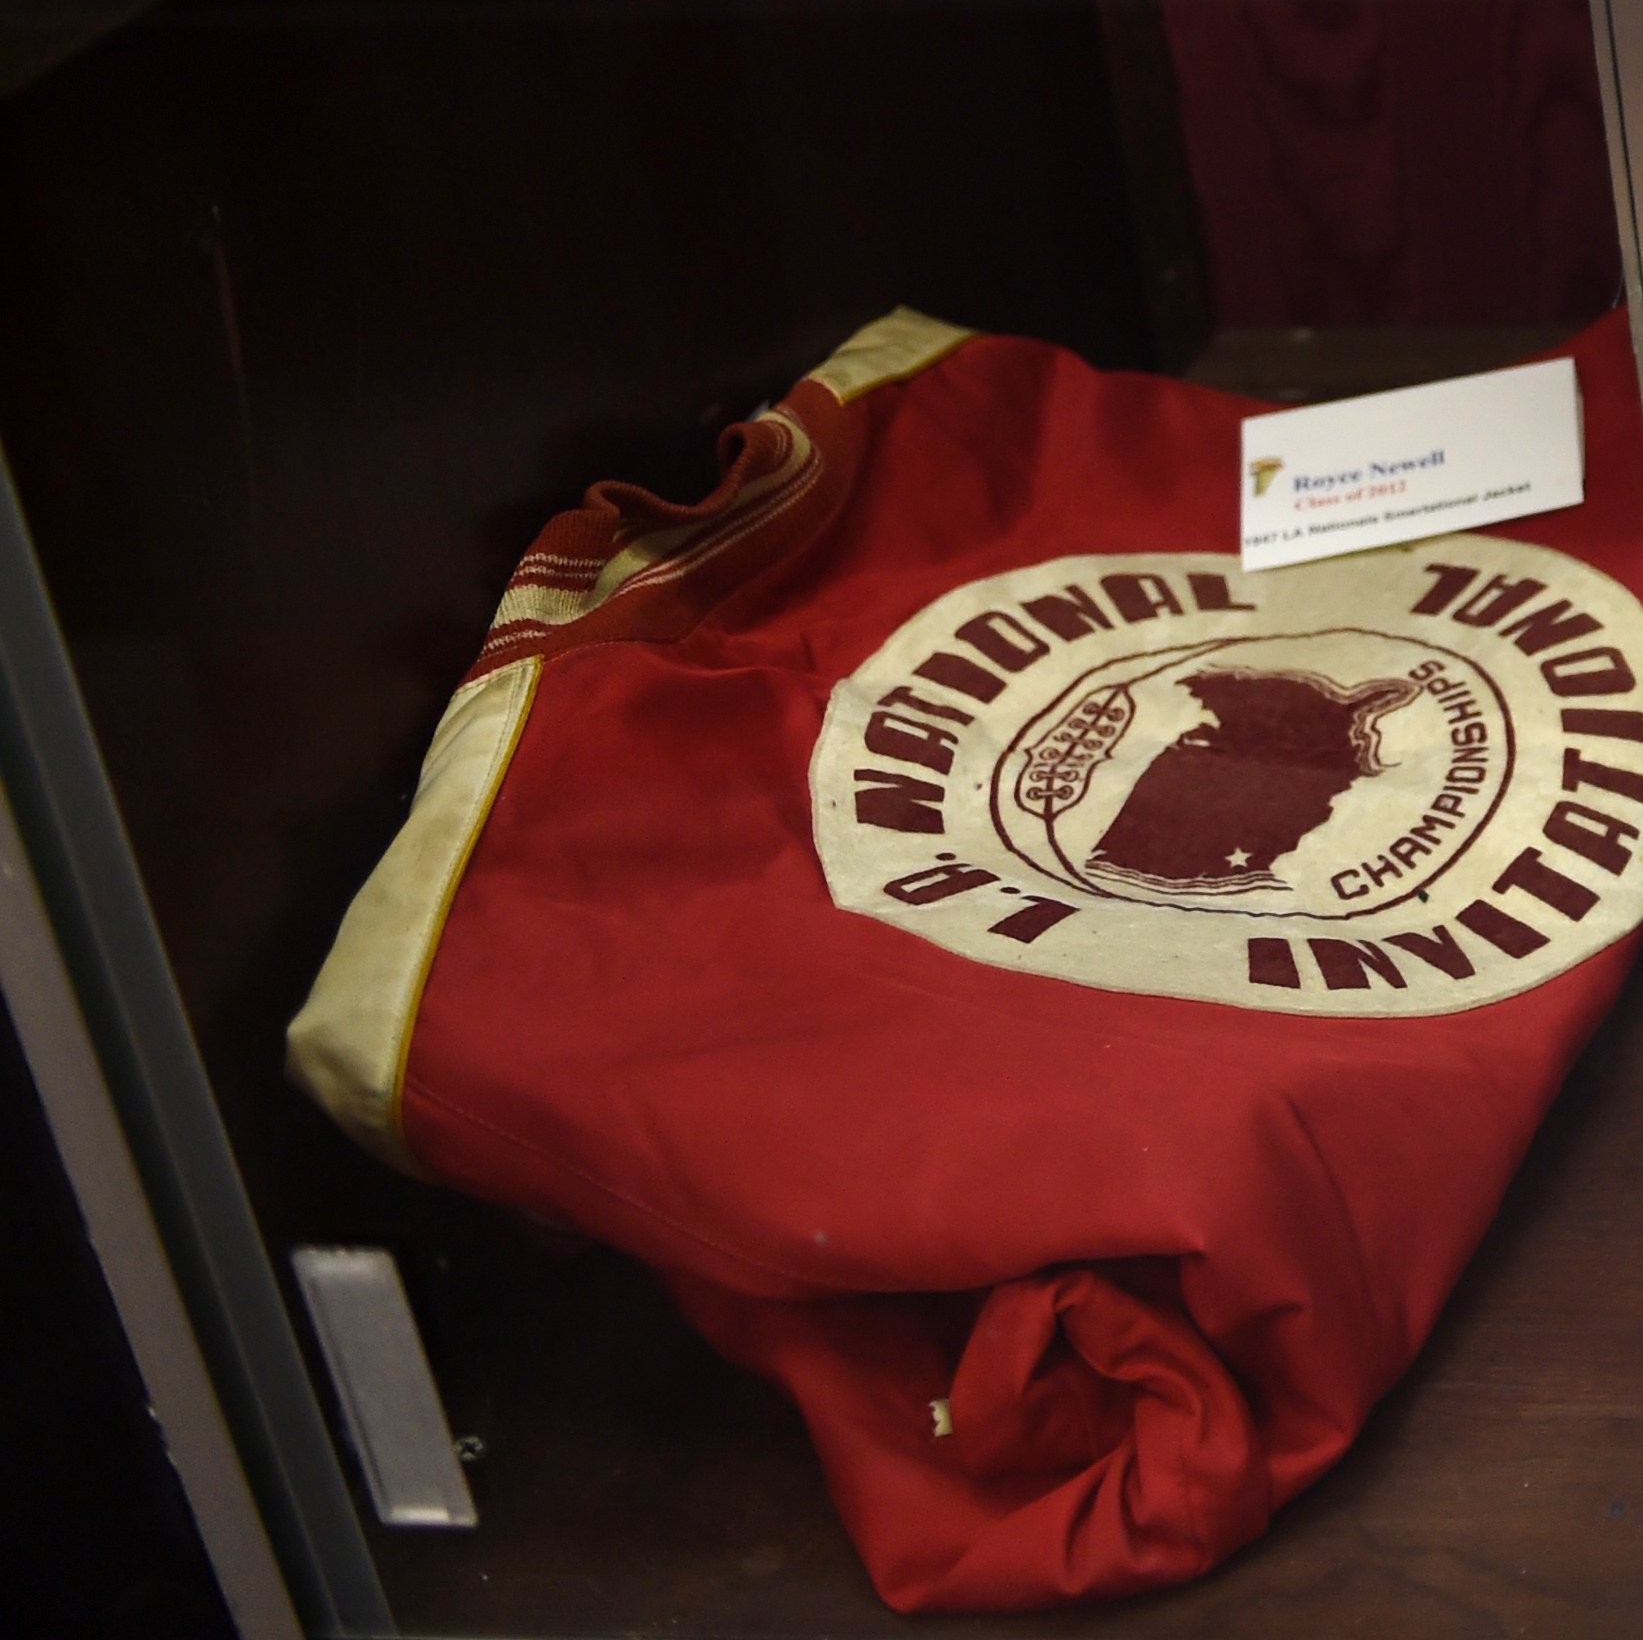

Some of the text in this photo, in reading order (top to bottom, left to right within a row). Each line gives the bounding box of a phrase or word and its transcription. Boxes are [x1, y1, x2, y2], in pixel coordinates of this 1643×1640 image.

[1293, 448, 1445, 493] Royce Newell
[1294, 494, 1341, 511] Class
[1345, 488, 1362, 501] of
[1308, 516, 1379, 537] Nationals
[1482, 481, 1532, 502] Jacket
[855, 570, 1258, 836] NATIONAL
[1329, 657, 1488, 902] CHAMPIONSHIPS
